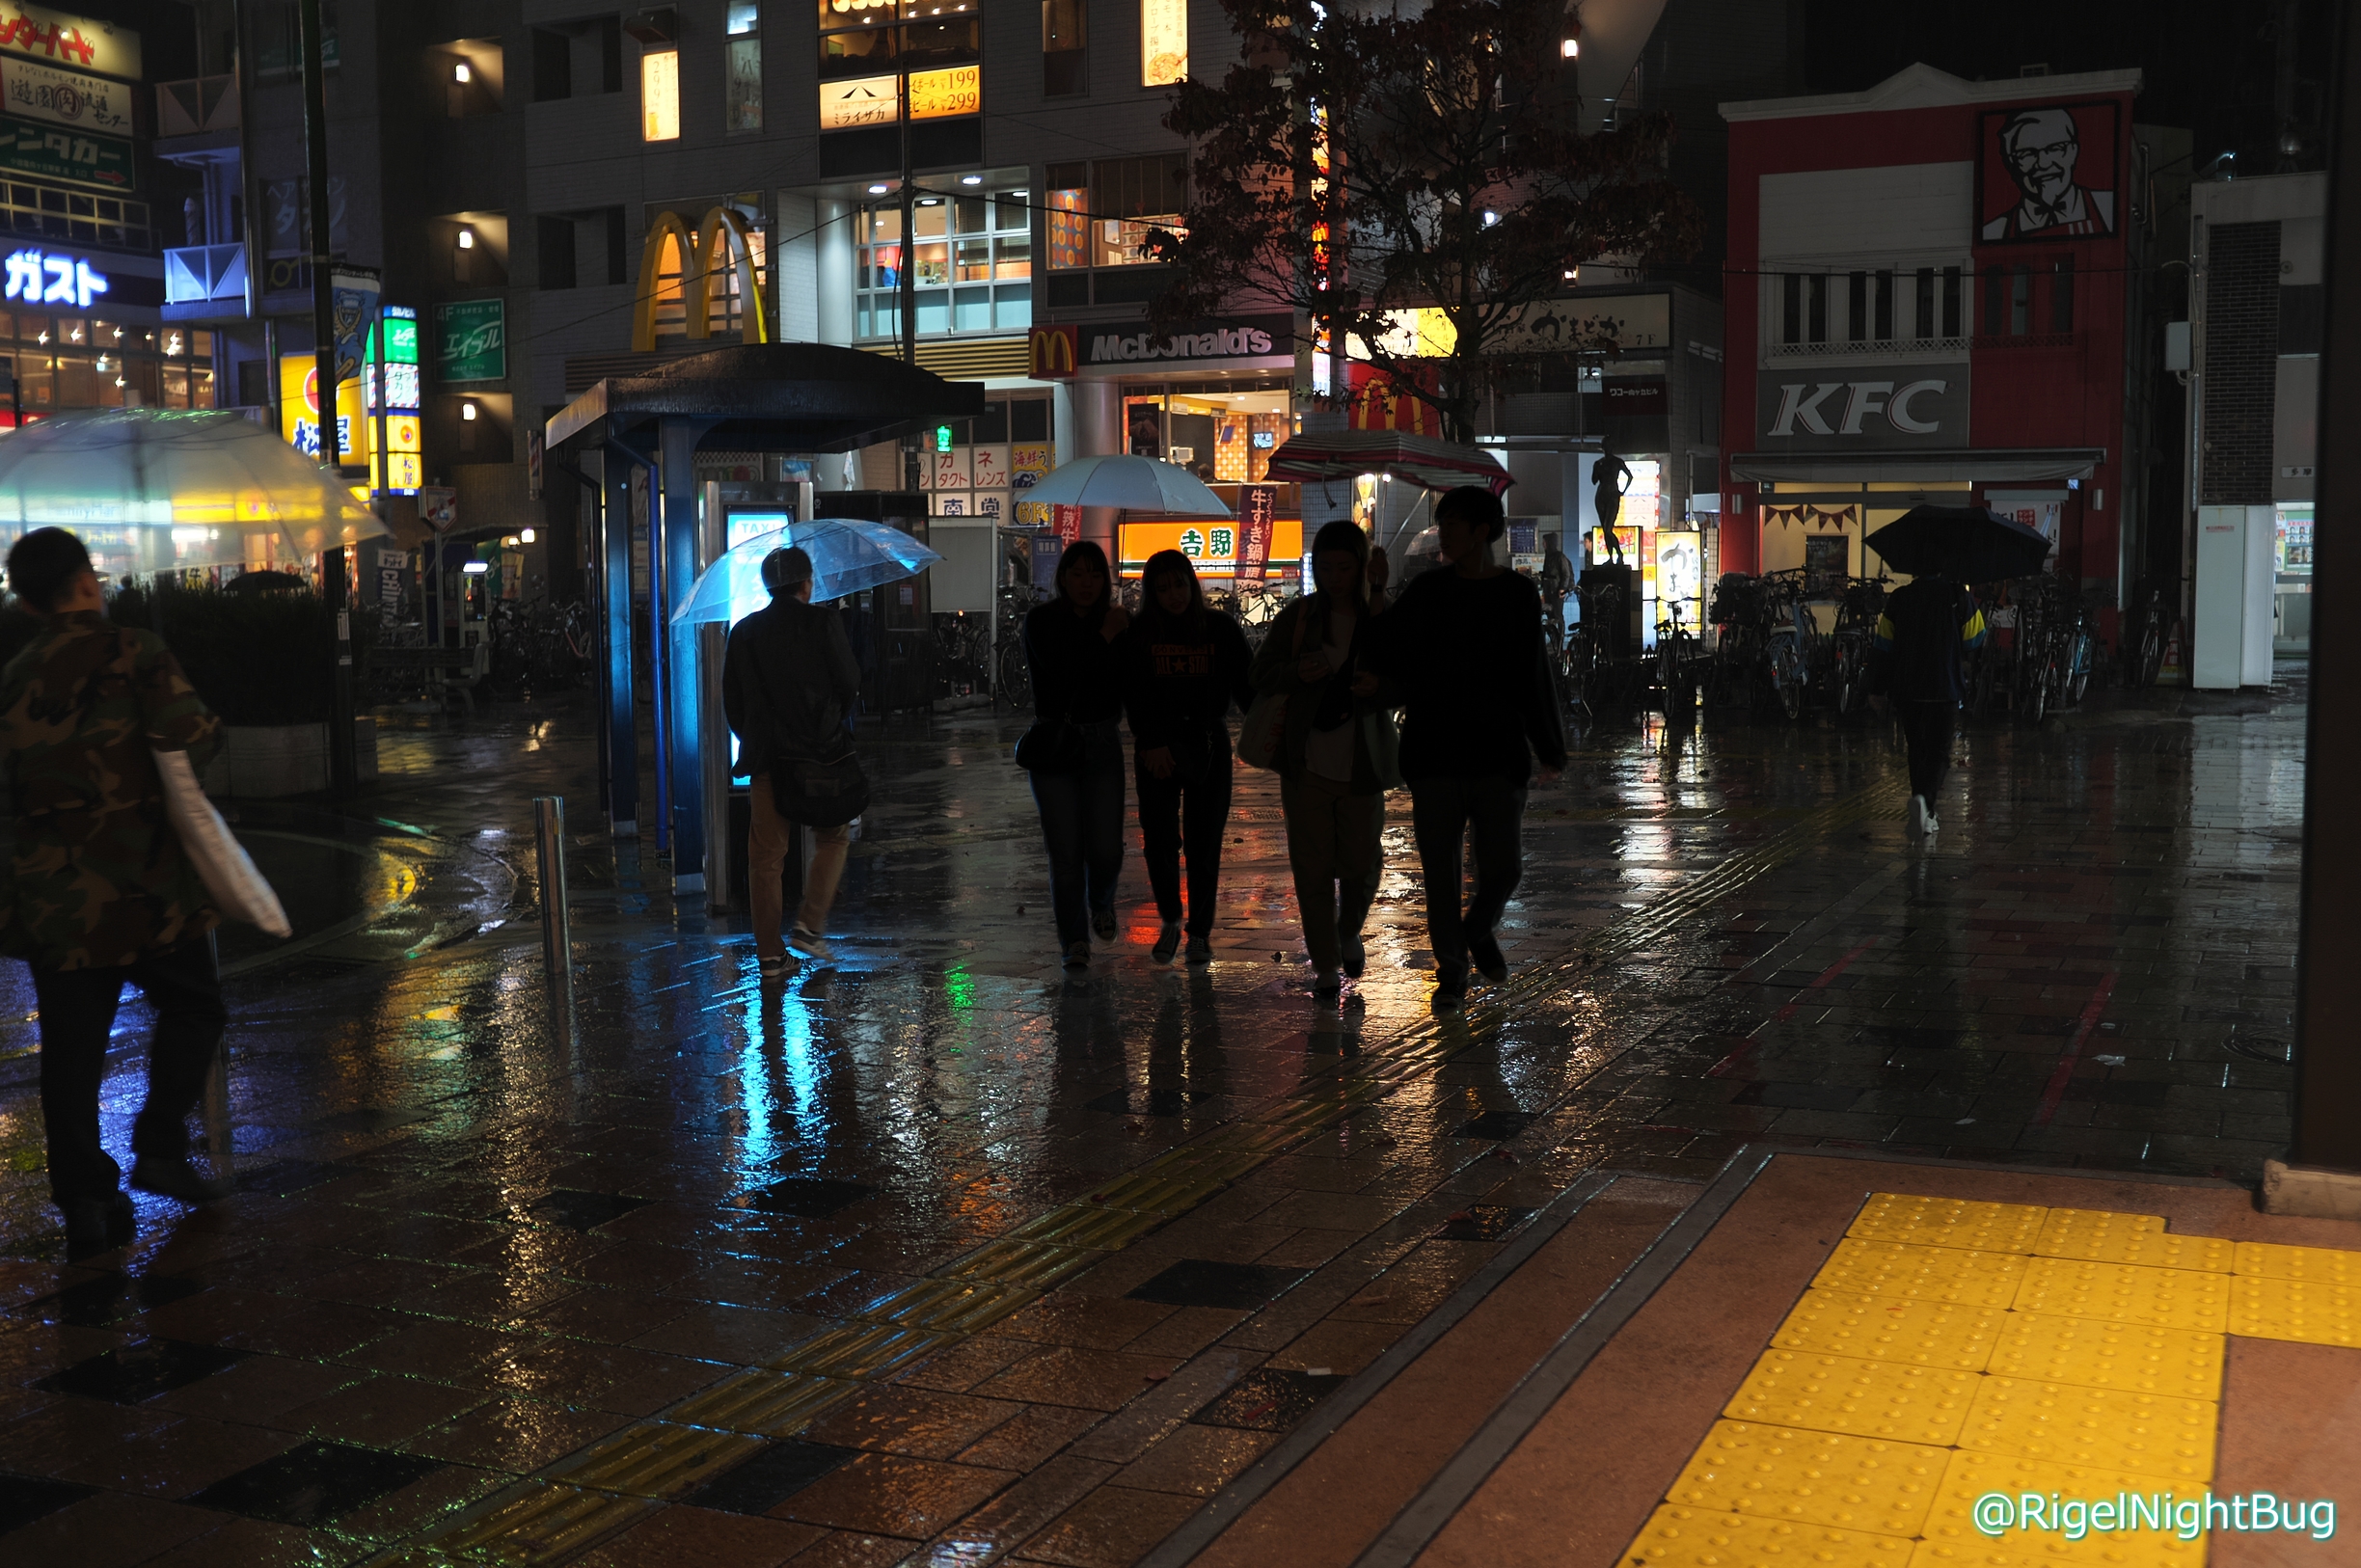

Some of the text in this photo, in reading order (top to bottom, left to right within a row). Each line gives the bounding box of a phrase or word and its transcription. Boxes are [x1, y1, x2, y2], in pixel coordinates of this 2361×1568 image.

[909, 78, 936, 91] イボール
[834, 108, 884, 124] ミライザカ
[5, 250, 108, 307] ガスト
[437, 306, 454, 321] 4F
[439, 320, 501, 359] エイブル
[1091, 326, 1272, 362] McDonald's
[1636, 334, 1656, 345] 7F
[1766, 378, 1948, 437] KFC
[403, 456, 413, 485] 松屋
[1018, 501, 1045, 524] 6F
[741, 523, 776, 534] TAXI
[1153, 645, 1207, 654] CONVERS
[1155, 655, 1208, 675] ALL STA
